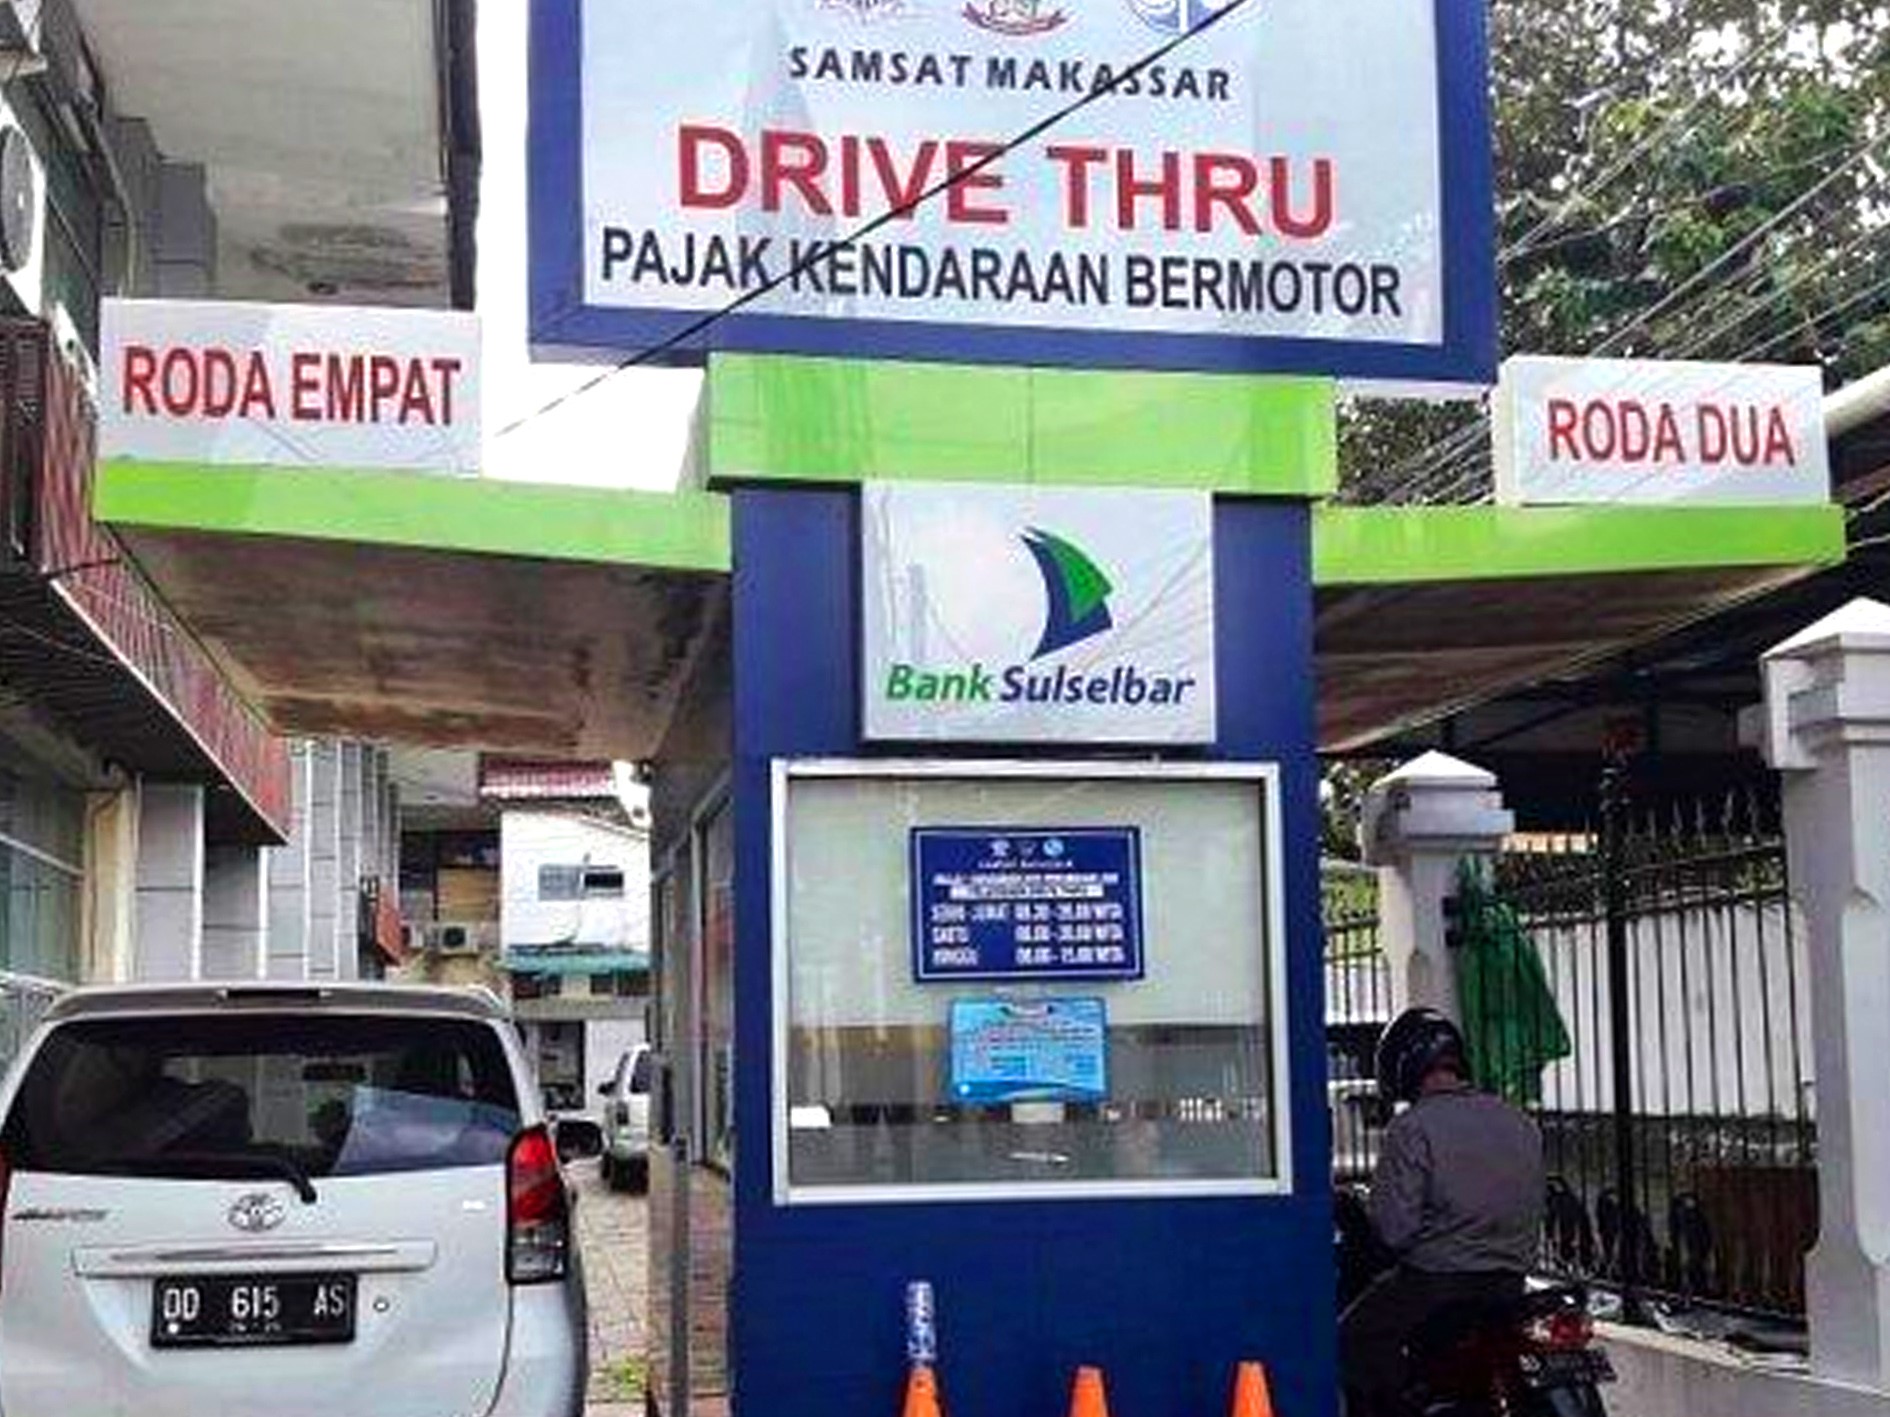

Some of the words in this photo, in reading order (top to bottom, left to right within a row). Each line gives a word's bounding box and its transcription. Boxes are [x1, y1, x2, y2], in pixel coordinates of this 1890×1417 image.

[789, 47, 971, 87] SAMSAT
[986, 57, 1230, 100] MAKASSAR
[678, 125, 1009, 226] DRIVE
[1046, 145, 1334, 237] THRU
[602, 227, 772, 288] PAJAK
[790, 239, 1110, 306] KENDARAAN
[1126, 254, 1402, 317] BERMOTOR
[122, 346, 275, 418] RODA
[291, 353, 461, 426] EMPAT
[1548, 399, 1686, 463] RODA
[1698, 404, 1796, 466] DUA
[885, 662, 994, 702] Bank
[999, 664, 1196, 705] Sulselbar
[231, 1286, 281, 1320] 615
[313, 1284, 345, 1317] AS
